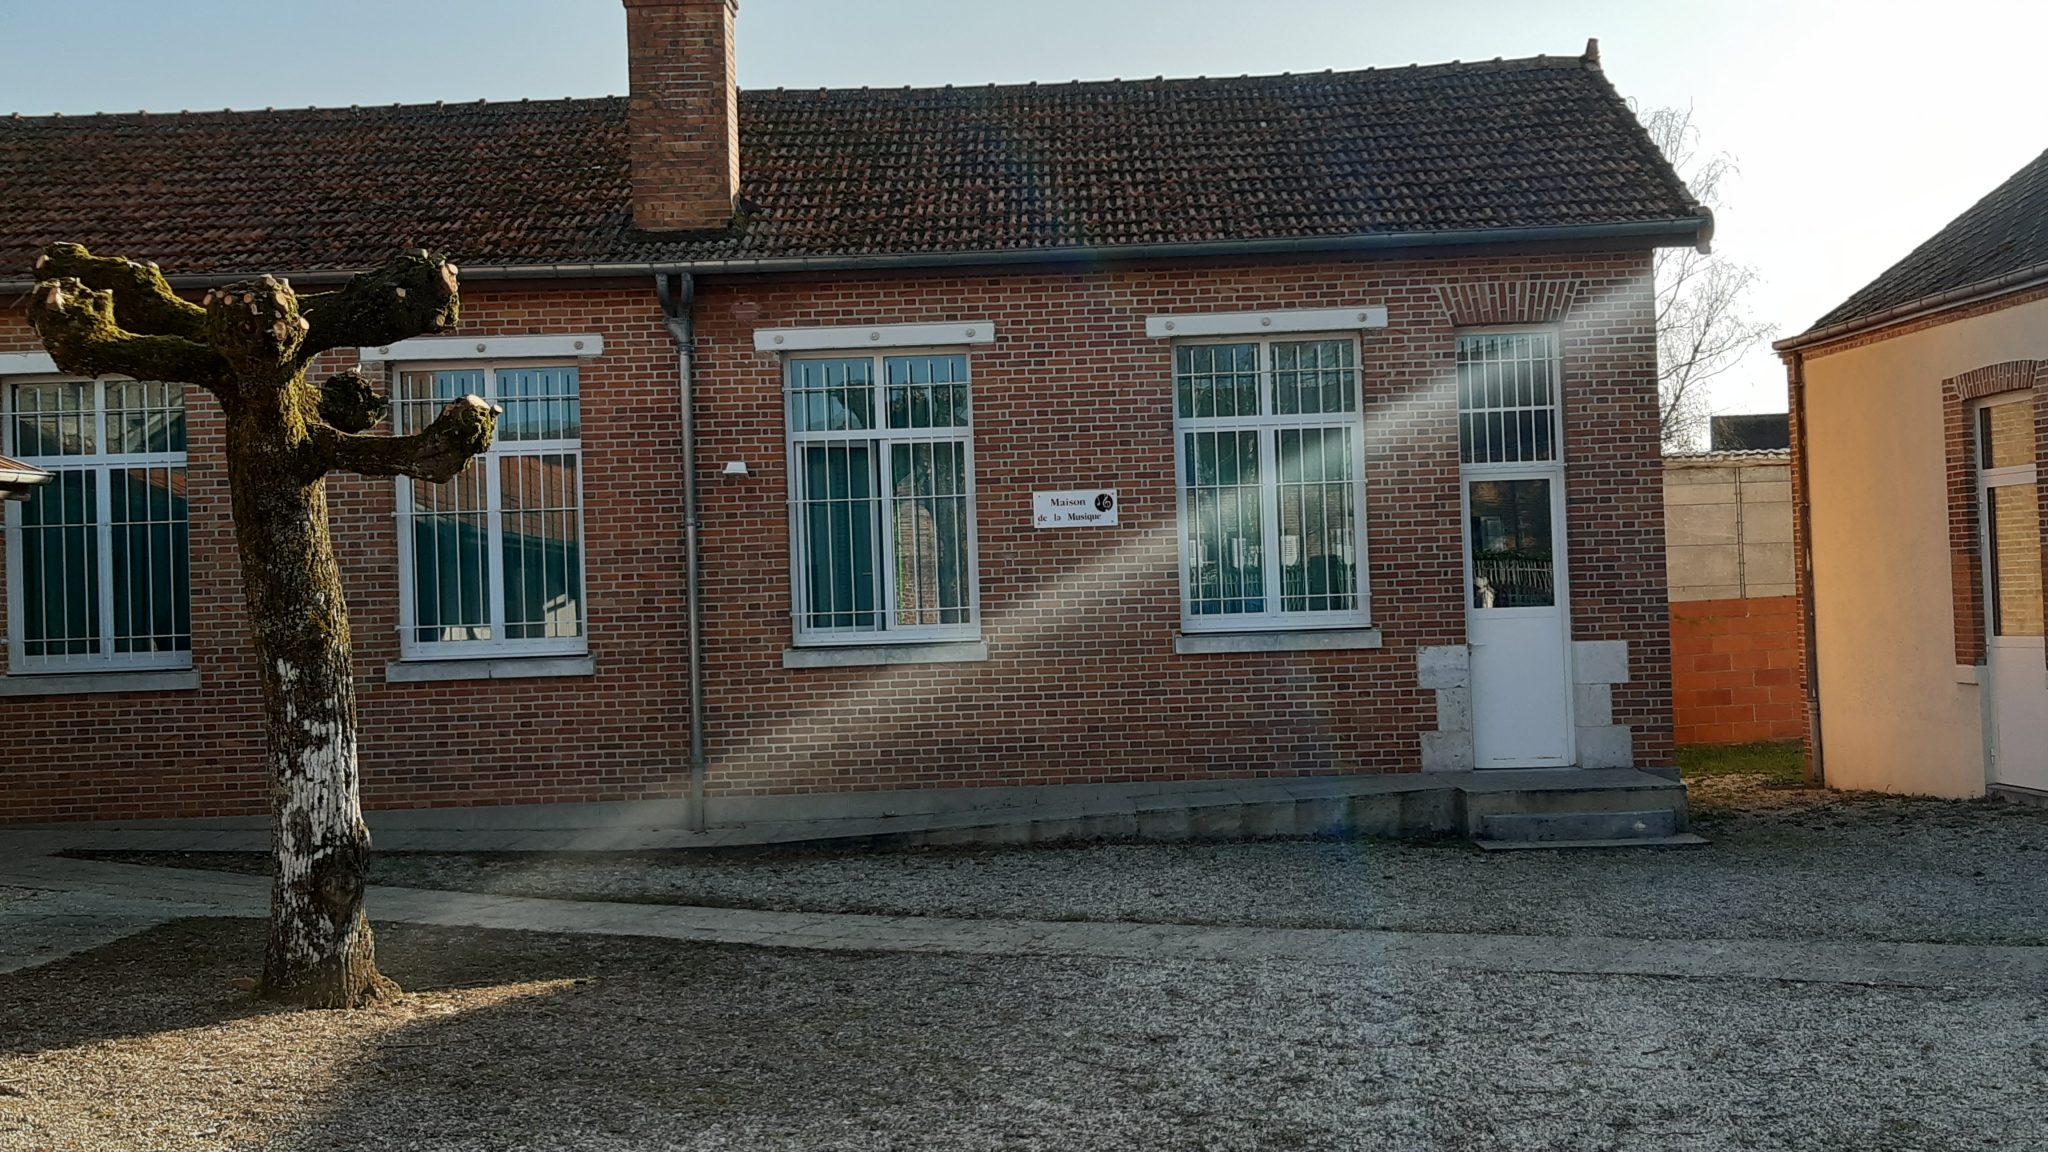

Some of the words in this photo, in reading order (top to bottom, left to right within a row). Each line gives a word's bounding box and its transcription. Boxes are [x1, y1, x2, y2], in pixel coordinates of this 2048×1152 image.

[1051, 498, 1086, 506] Maison
[1054, 513, 1061, 521] la
[1068, 513, 1101, 522] Musique
